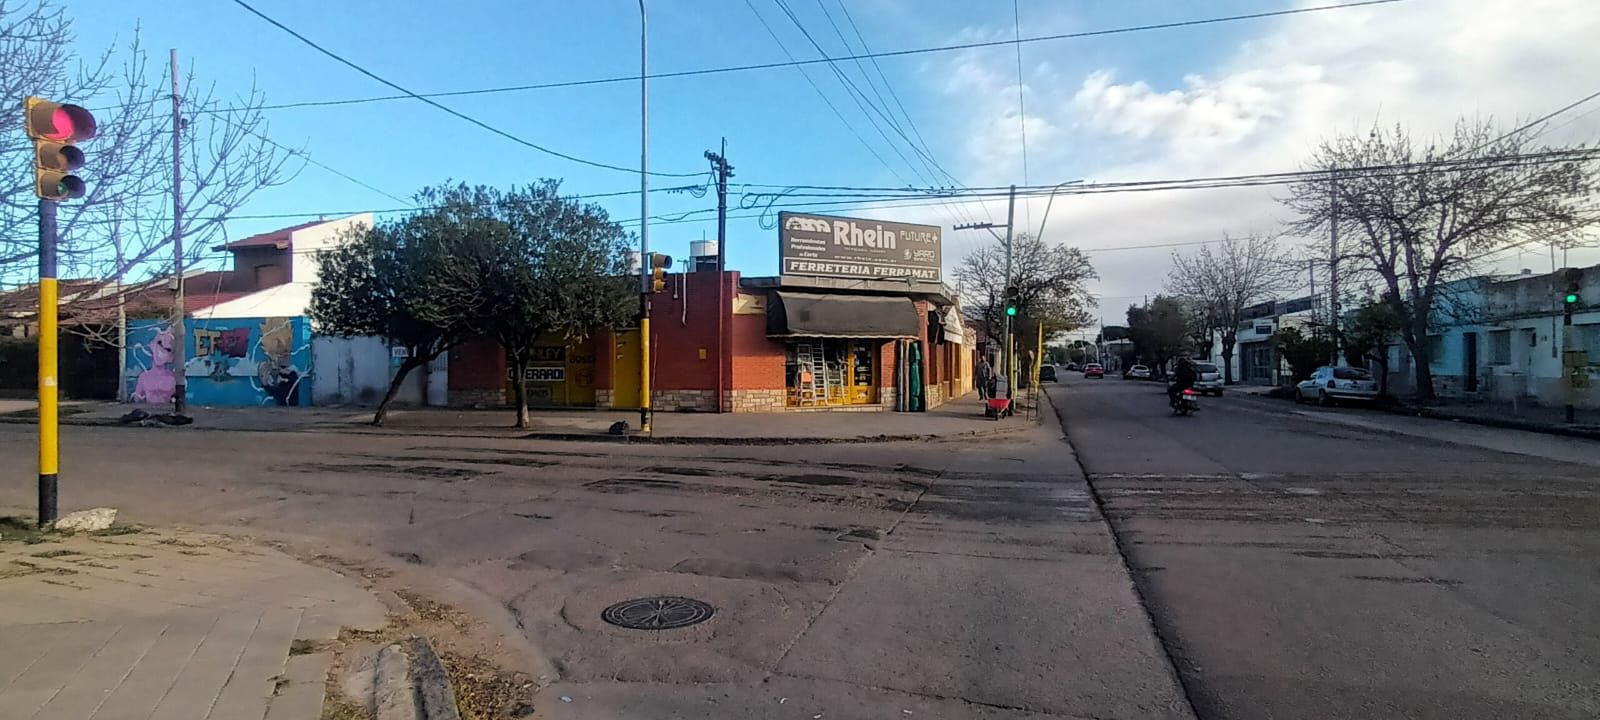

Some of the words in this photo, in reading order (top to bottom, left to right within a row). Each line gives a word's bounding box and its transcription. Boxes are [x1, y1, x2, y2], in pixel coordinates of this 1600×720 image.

[834, 221, 896, 249] Rhein
[790, 261, 870, 275] FERRETERIA
[873, 266, 936, 279] FERRAMAT
[509, 369, 562, 379] GERARDI
